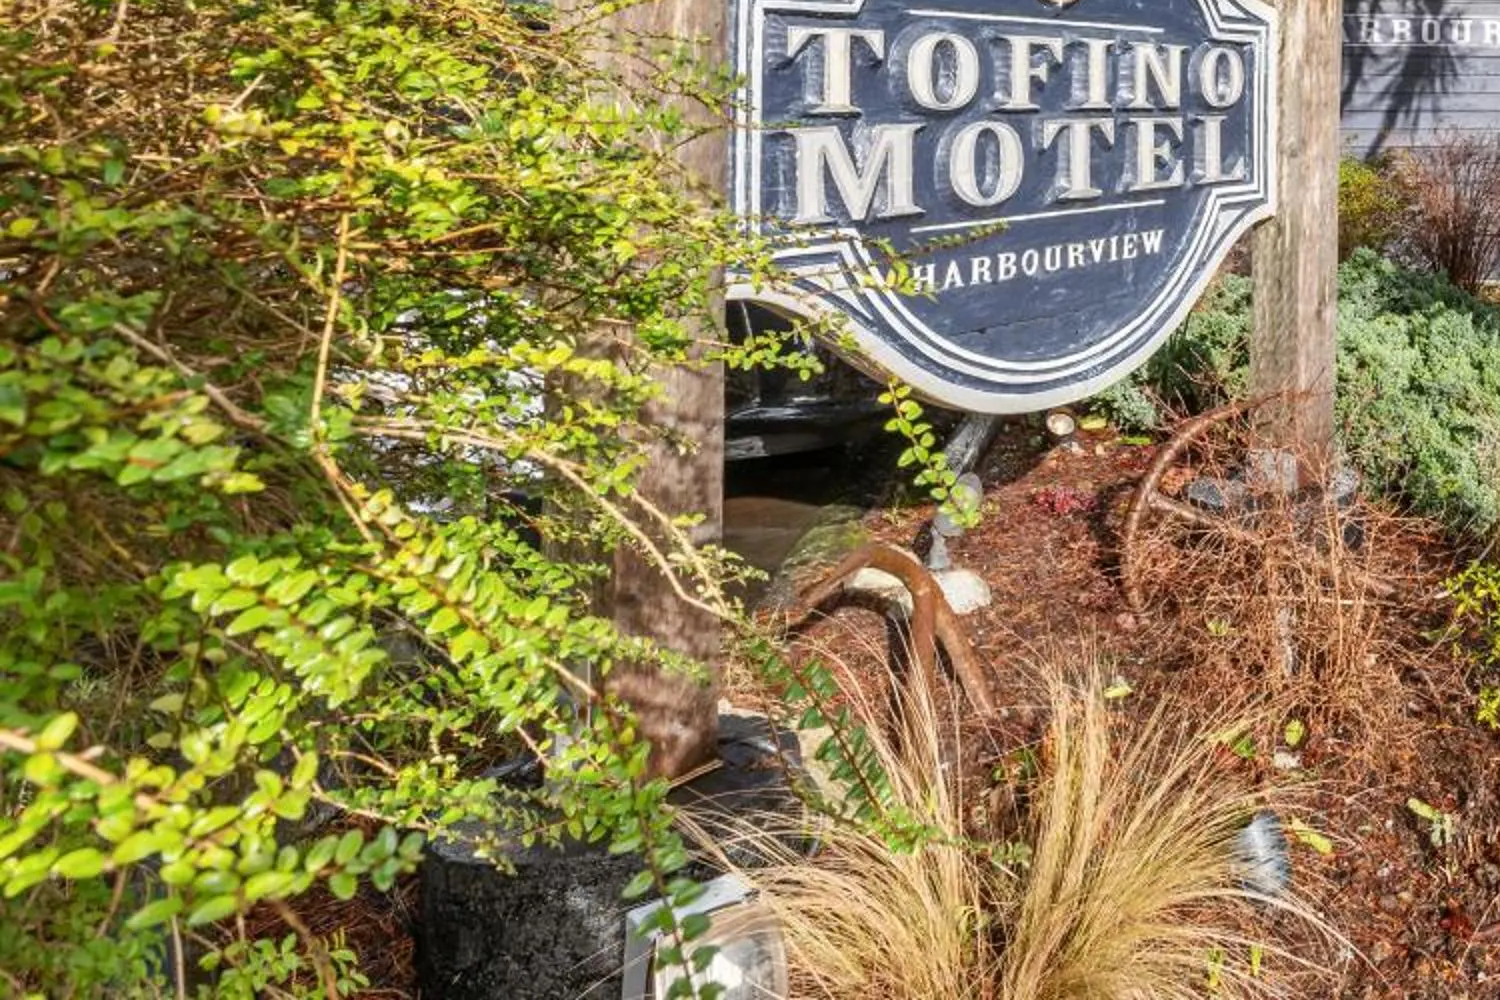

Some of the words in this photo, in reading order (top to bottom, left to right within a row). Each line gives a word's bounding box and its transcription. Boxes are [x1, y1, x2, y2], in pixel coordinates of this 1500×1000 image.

[787, 25, 1246, 114] TOFINO
[786, 114, 1246, 224] MOTEL
[913, 229, 1165, 292] HARBOURVIEW
